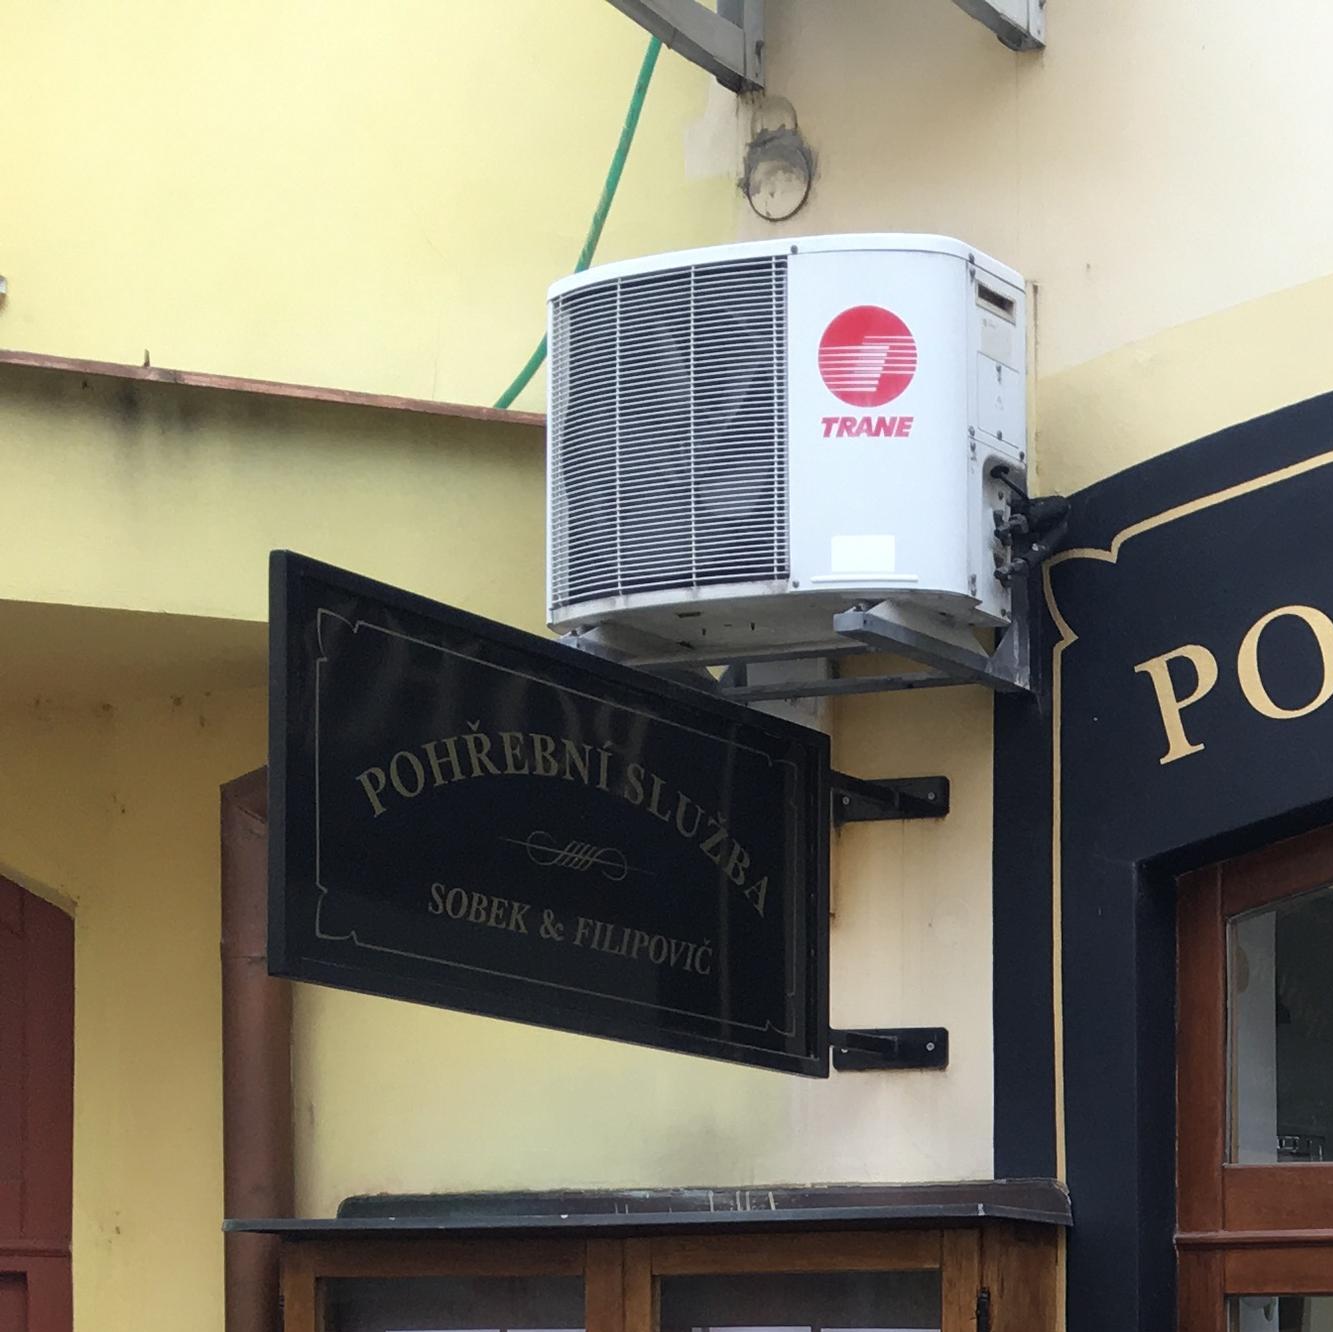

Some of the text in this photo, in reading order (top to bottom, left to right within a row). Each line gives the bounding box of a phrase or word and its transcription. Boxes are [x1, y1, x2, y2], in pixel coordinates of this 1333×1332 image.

[821, 416, 914, 438] TRANE
[355, 719, 770, 918] POHŘEBNÍ SLUŽBA
[427, 881, 714, 976] SOBEK & FILIPOVIČ
